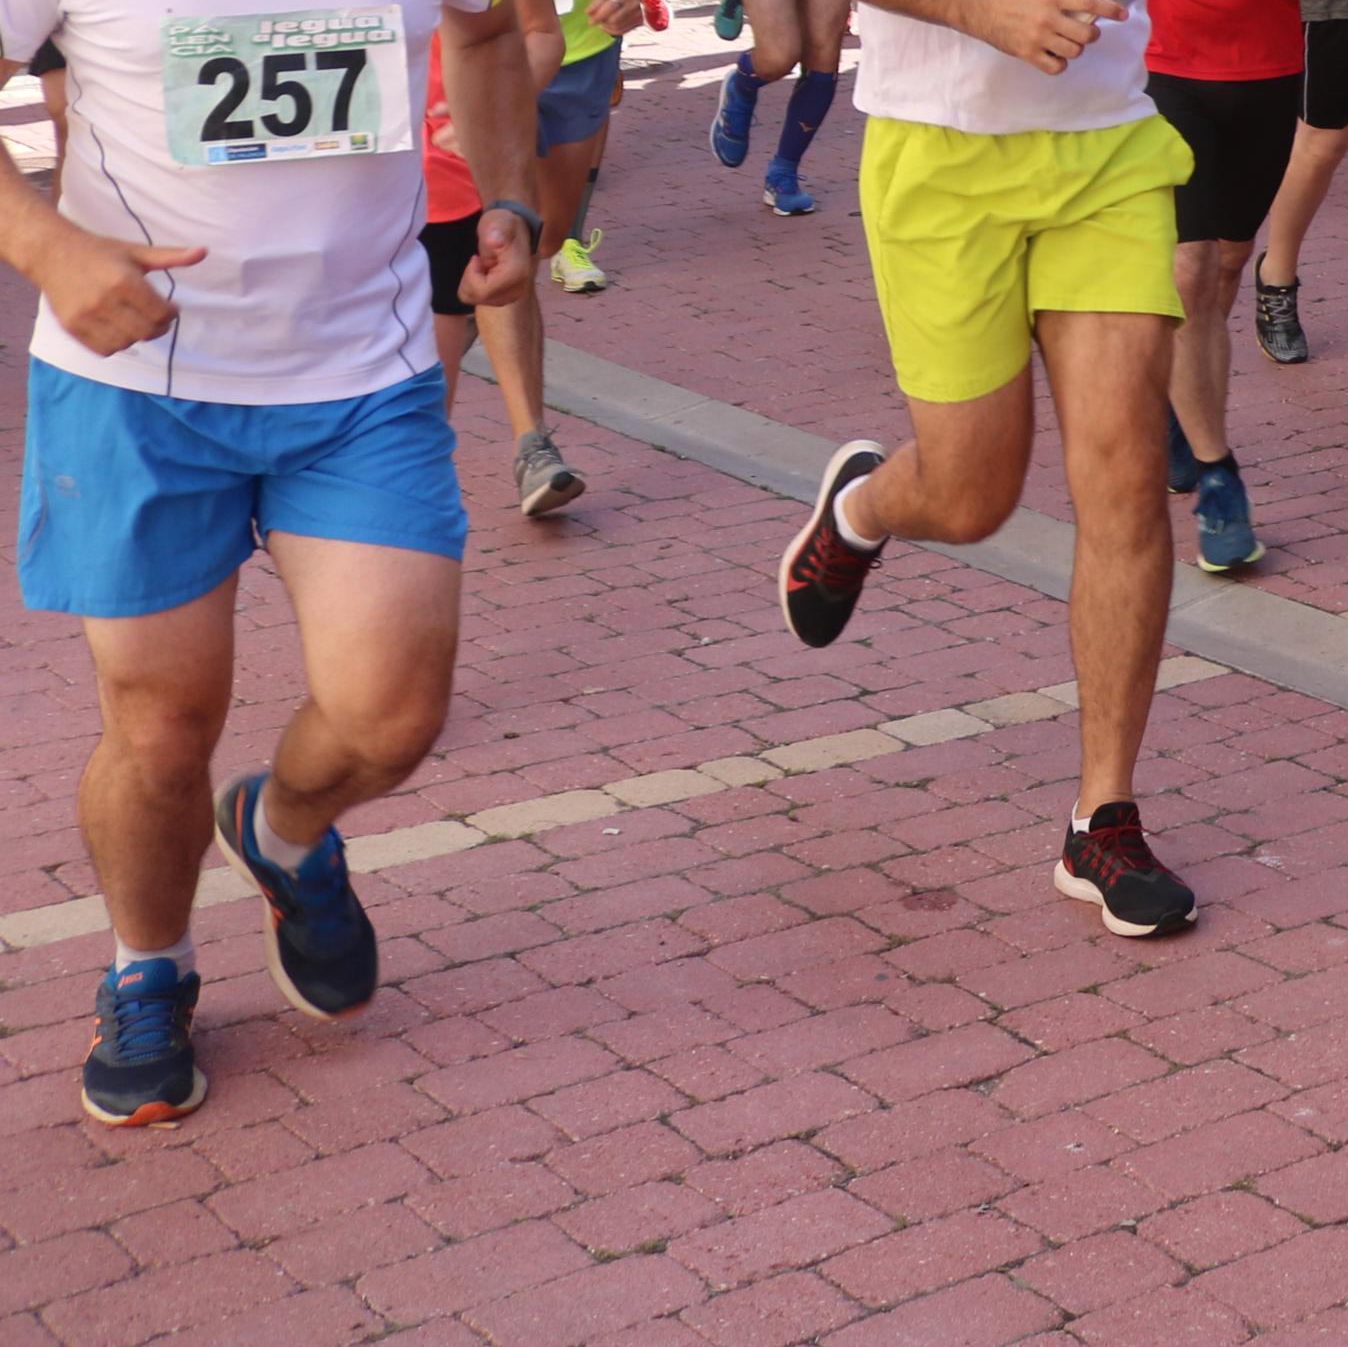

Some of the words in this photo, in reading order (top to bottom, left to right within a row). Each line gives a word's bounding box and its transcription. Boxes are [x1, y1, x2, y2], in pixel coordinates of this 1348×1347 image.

[260, 15, 385, 36] legua
[272, 29, 397, 51] legua
[197, 48, 368, 143] 257
